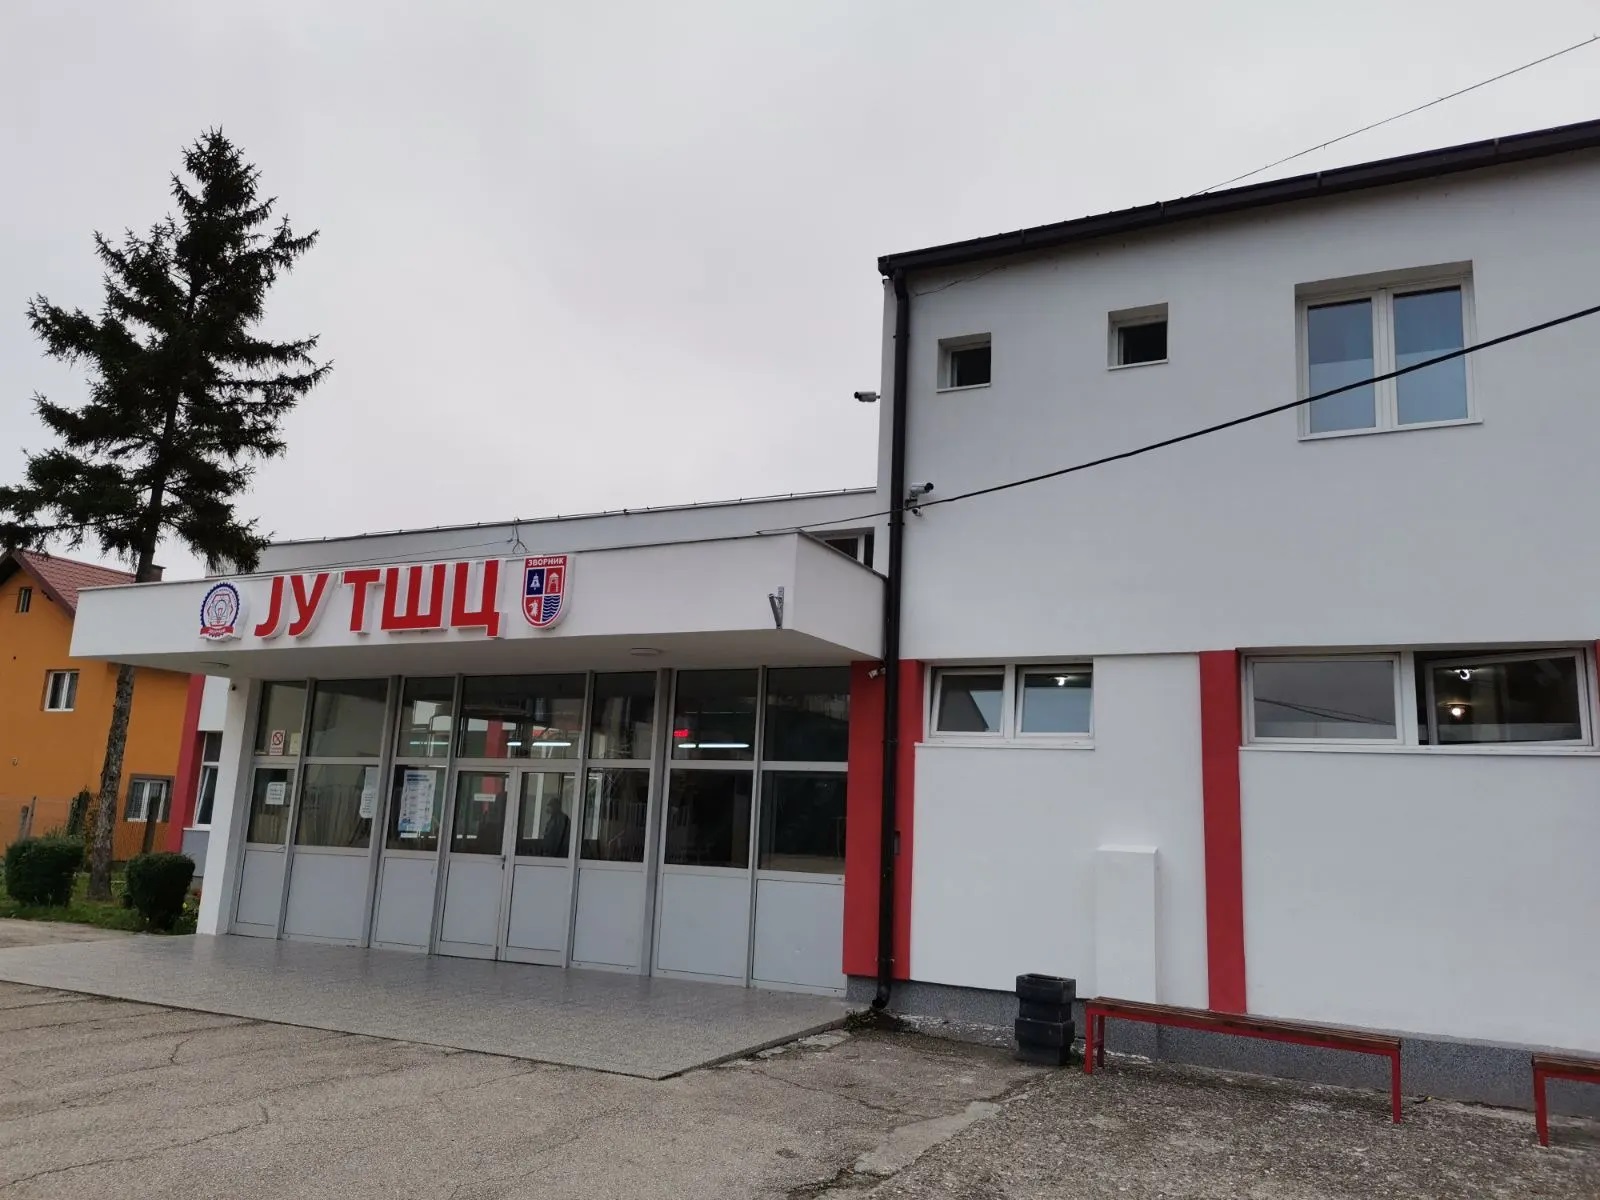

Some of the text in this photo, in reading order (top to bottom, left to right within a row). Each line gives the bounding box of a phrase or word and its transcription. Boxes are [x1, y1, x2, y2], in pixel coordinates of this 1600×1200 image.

[528, 557, 564, 566] ЗВОРНИК
[254, 560, 500, 637] ЈУ ТШЦ
